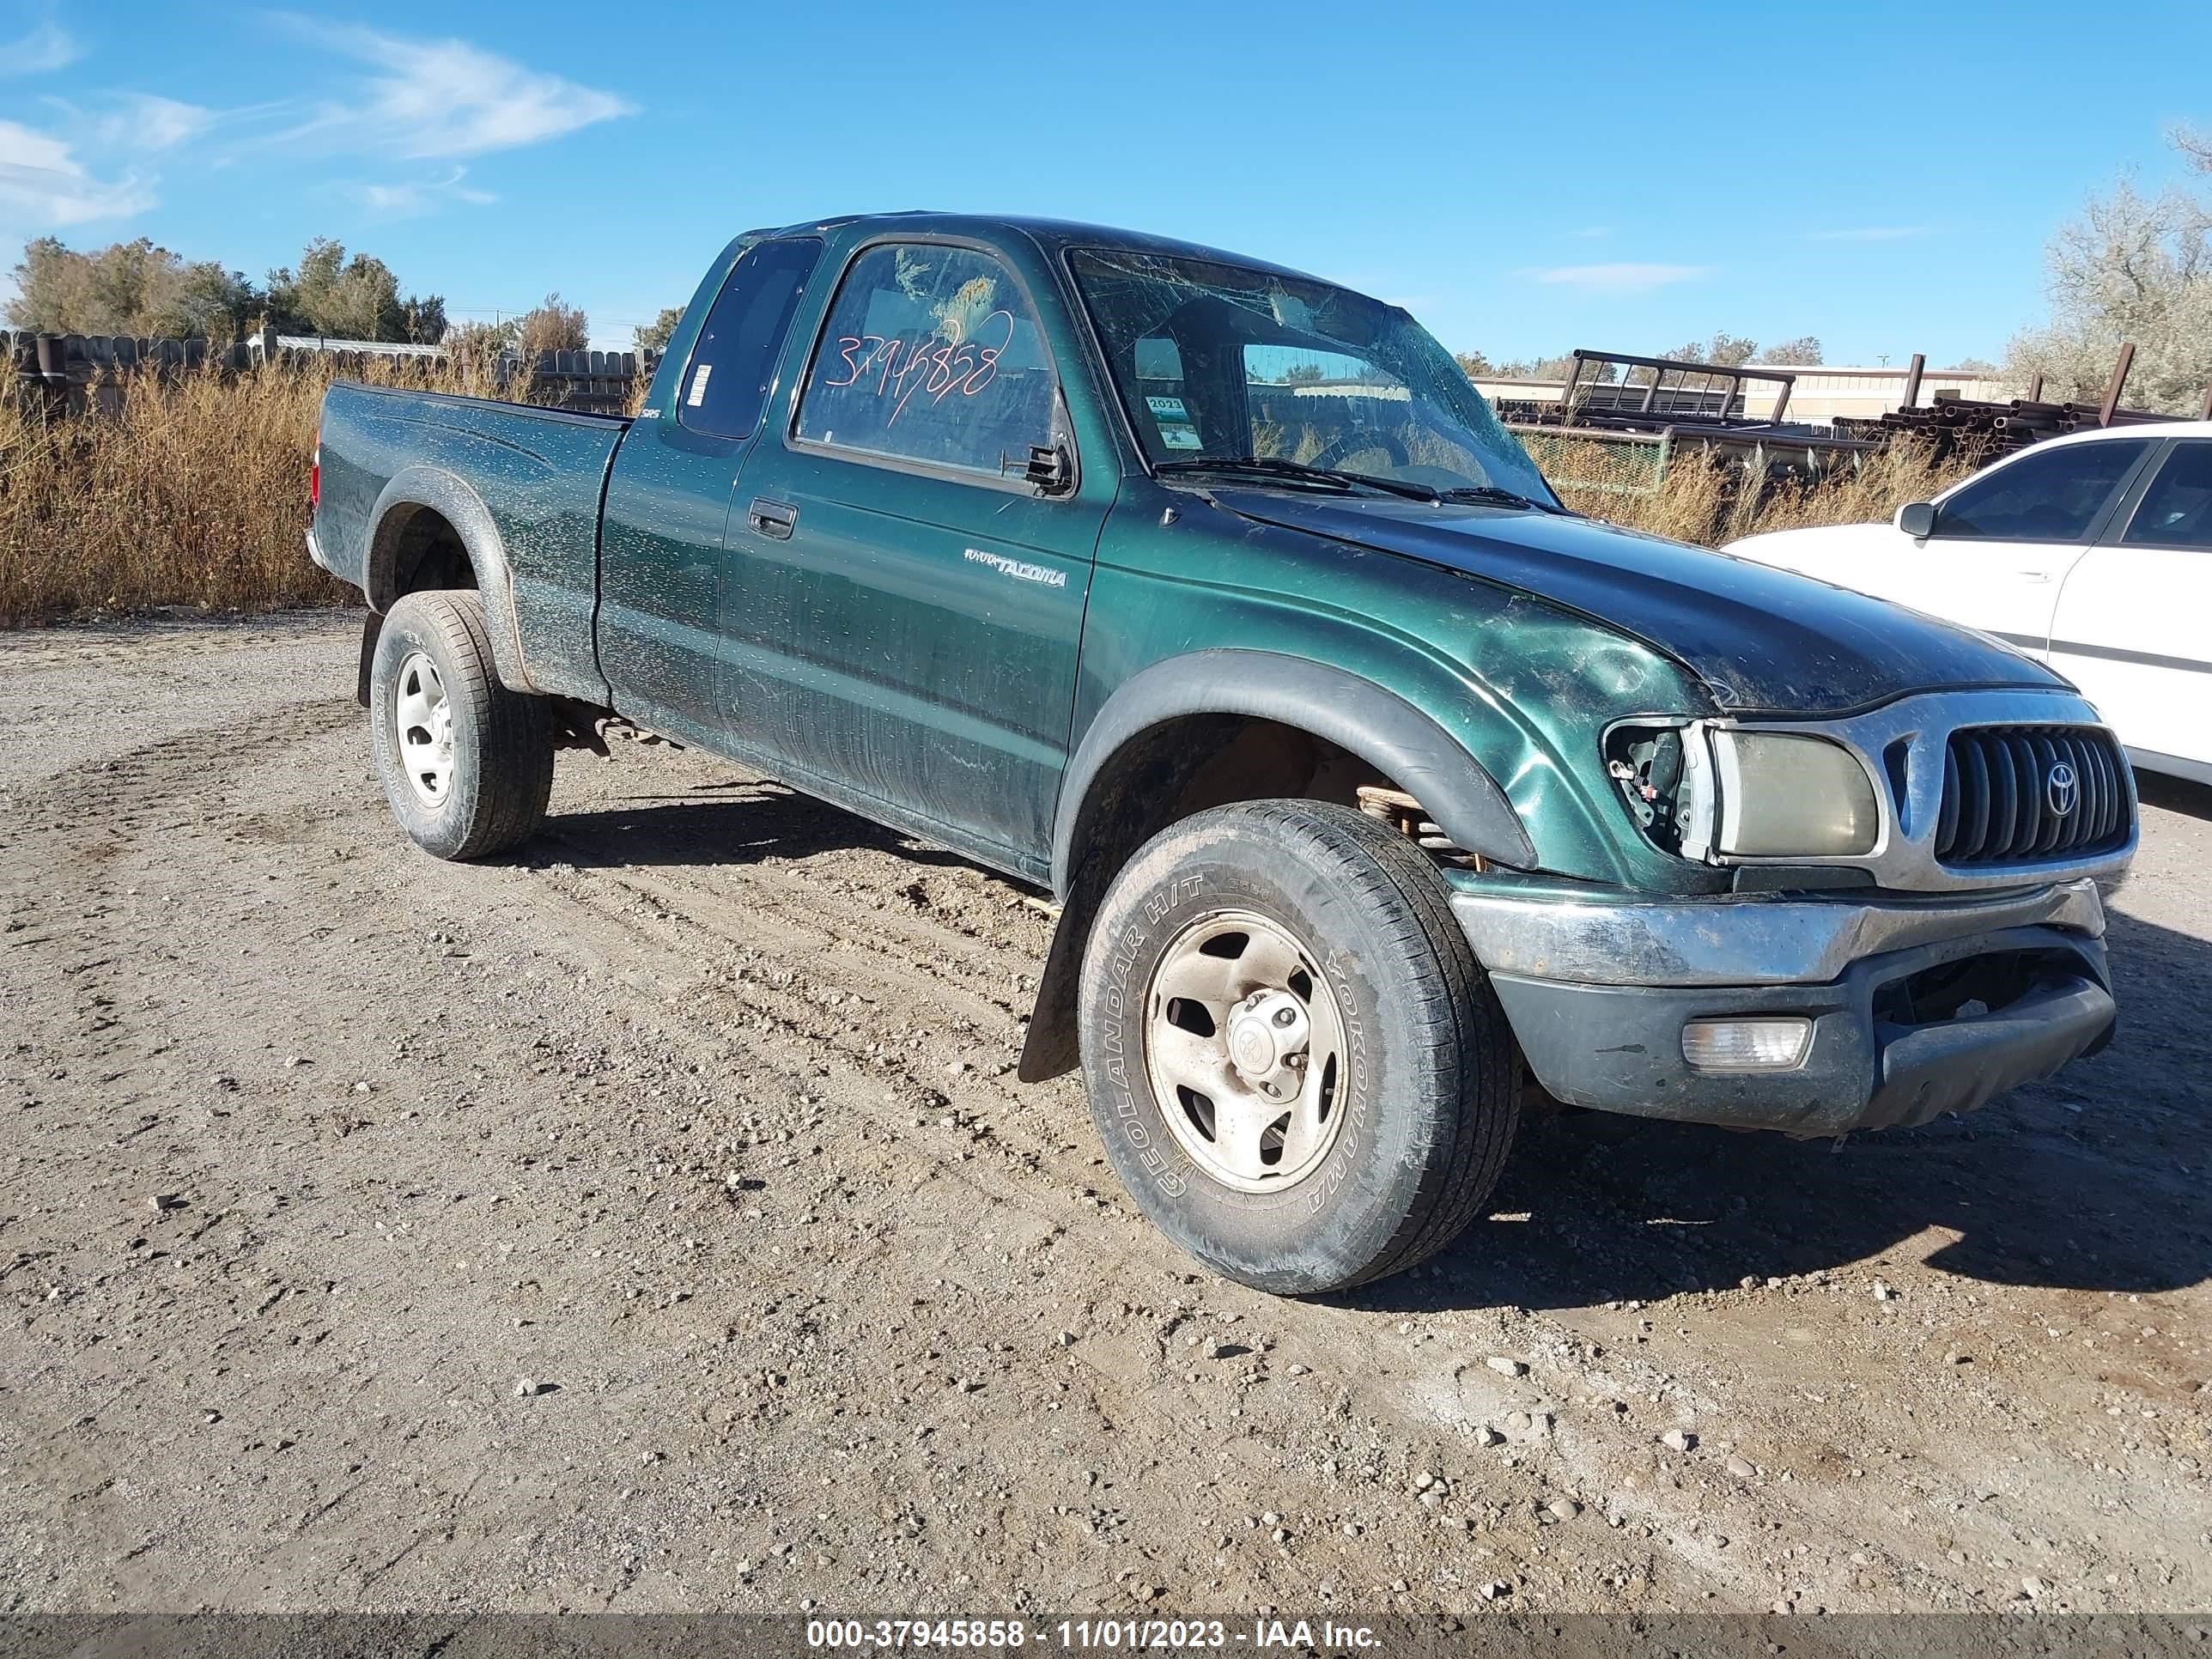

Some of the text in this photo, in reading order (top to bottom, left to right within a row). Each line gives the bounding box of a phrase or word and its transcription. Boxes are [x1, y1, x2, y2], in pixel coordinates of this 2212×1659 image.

[825, 310, 1013, 428] 37945858
[1150, 399, 1182, 409] 2023
[998, 557, 1067, 587] TACOMA
[377, 684, 410, 812] YOKOHAMA
[1105, 875, 1204, 1196] GEOLANDAR H/T
[1308, 951, 1369, 1214] YOKOHAMA
